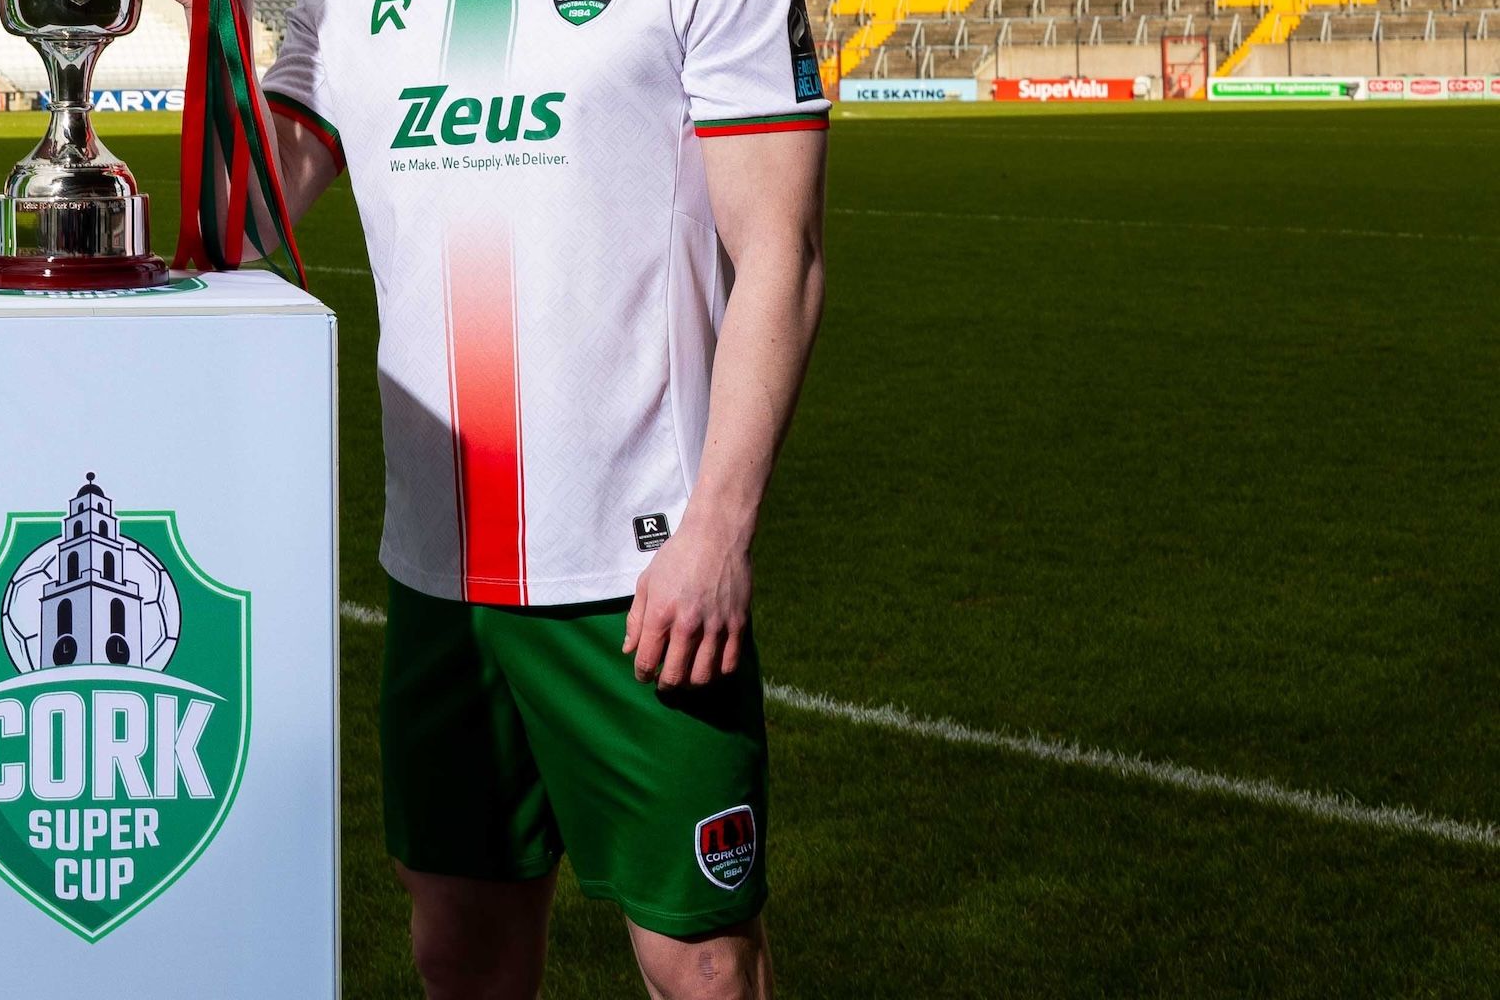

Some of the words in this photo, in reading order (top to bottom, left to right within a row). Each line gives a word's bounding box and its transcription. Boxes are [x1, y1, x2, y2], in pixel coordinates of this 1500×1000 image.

[558, 1, 588, 10] FOOTBALL
[589, 0, 606, 9] CLUB
[568, 9, 591, 17] 1984
[857, 89, 879, 99] ICE
[883, 89, 946, 99] SKATING
[1019, 80, 1108, 101] SuperValu
[390, 84, 566, 149] Zeus
[390, 160, 406, 172] We
[408, 158, 439, 171] Make.
[442, 157, 460, 170] We
[463, 155, 503, 171] Supply.
[505, 154, 521, 166] We
[522, 152, 569, 166] Deliver.
[53, 202, 68, 210] Cork
[69, 202, 82, 210] City
[29, 807, 160, 851] SUPER
[705, 850, 735, 863] CORK
[712, 859, 738, 873] FOOTBALL
[723, 866, 743, 879] 1984
[55, 856, 134, 901] CUP
